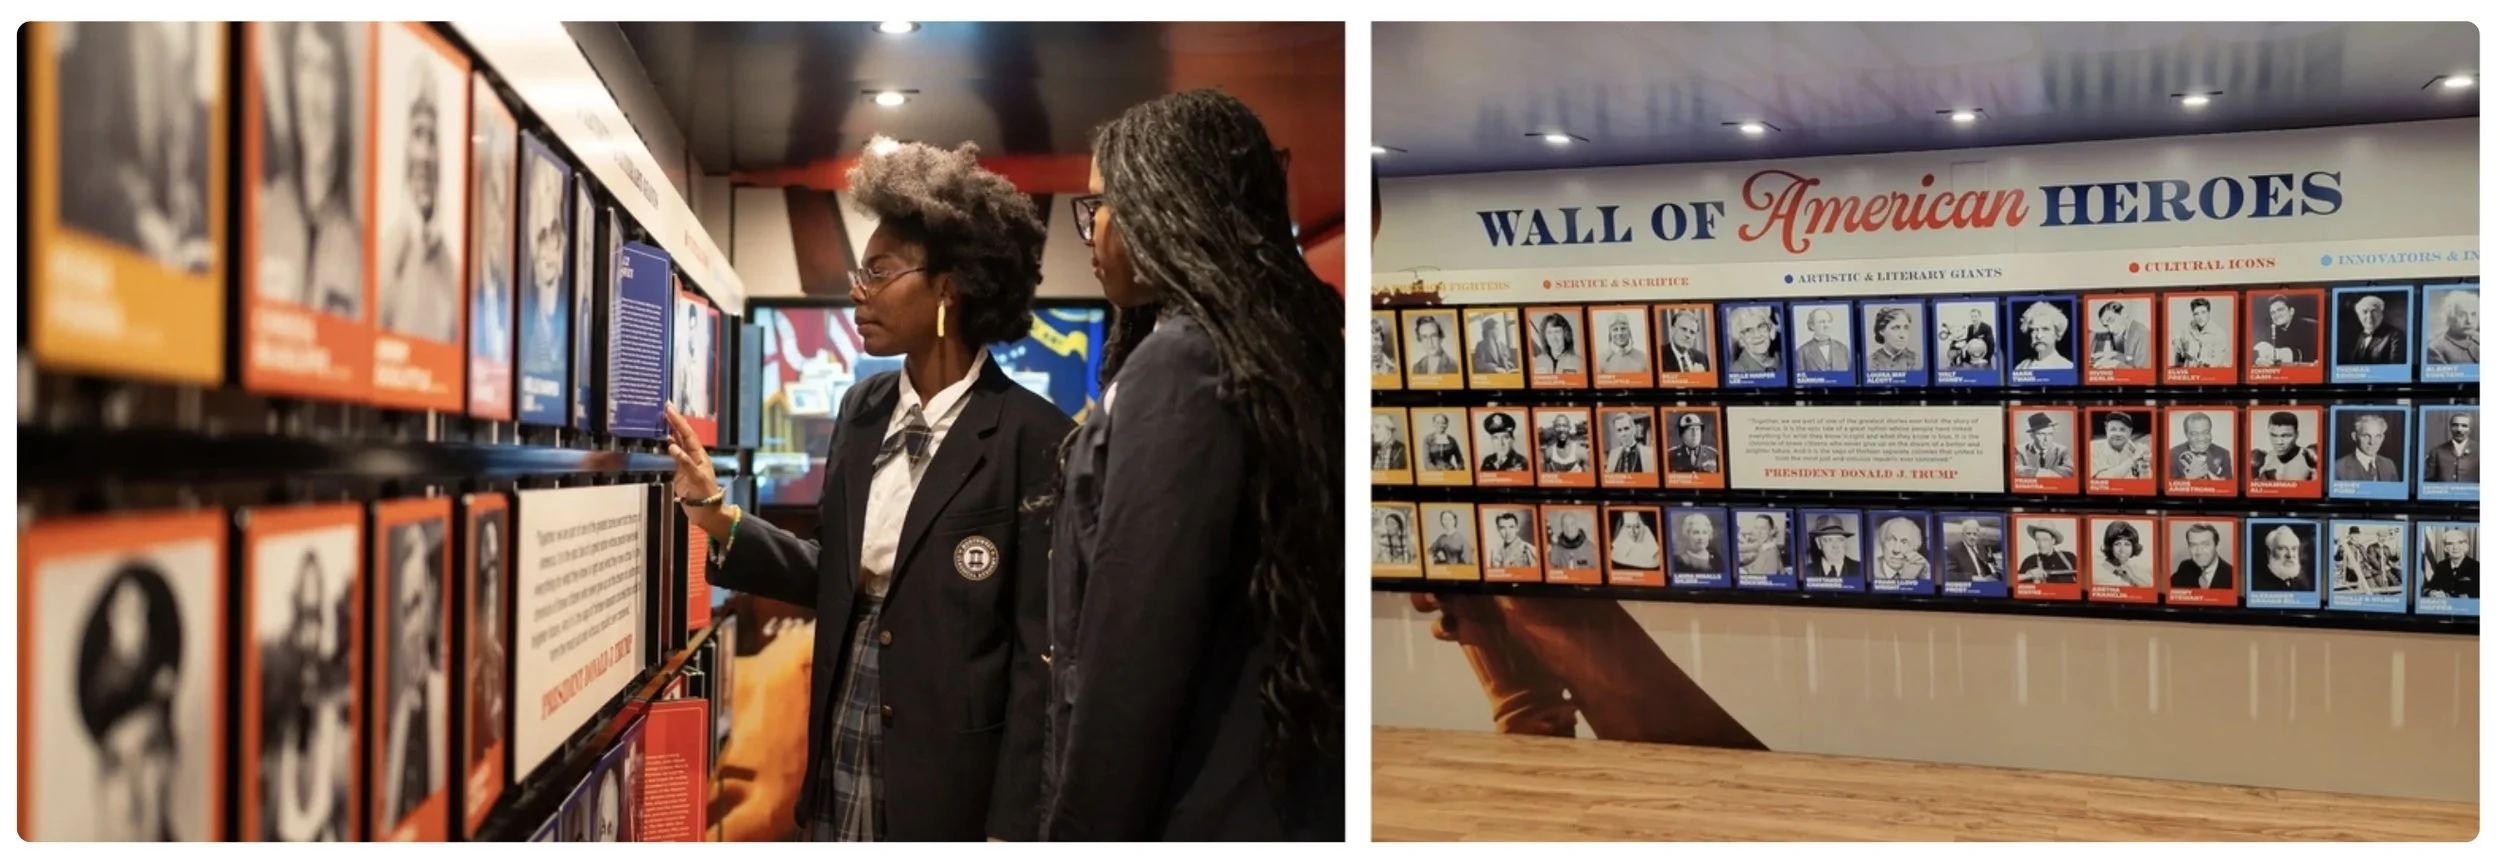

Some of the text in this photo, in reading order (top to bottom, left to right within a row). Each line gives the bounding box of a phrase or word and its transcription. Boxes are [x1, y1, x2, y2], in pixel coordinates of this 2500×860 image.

[1476, 170, 2343, 255] WALL OF American HEROES
[2144, 257, 2276, 273] CULTURAL ICONS
[2338, 251, 2441, 265] INNOVATORS
[2447, 250, 2459, 262] &
[1555, 277, 1689, 289] SERVICE & SACRIFICE
[1798, 267, 2003, 284] ARTISTIC & LITERARY GIANTS
[1764, 467, 1837, 478] PRESIDENT
[1841, 468, 1894, 479] DONALD
[1912, 469, 1959, 479] TRUMP
